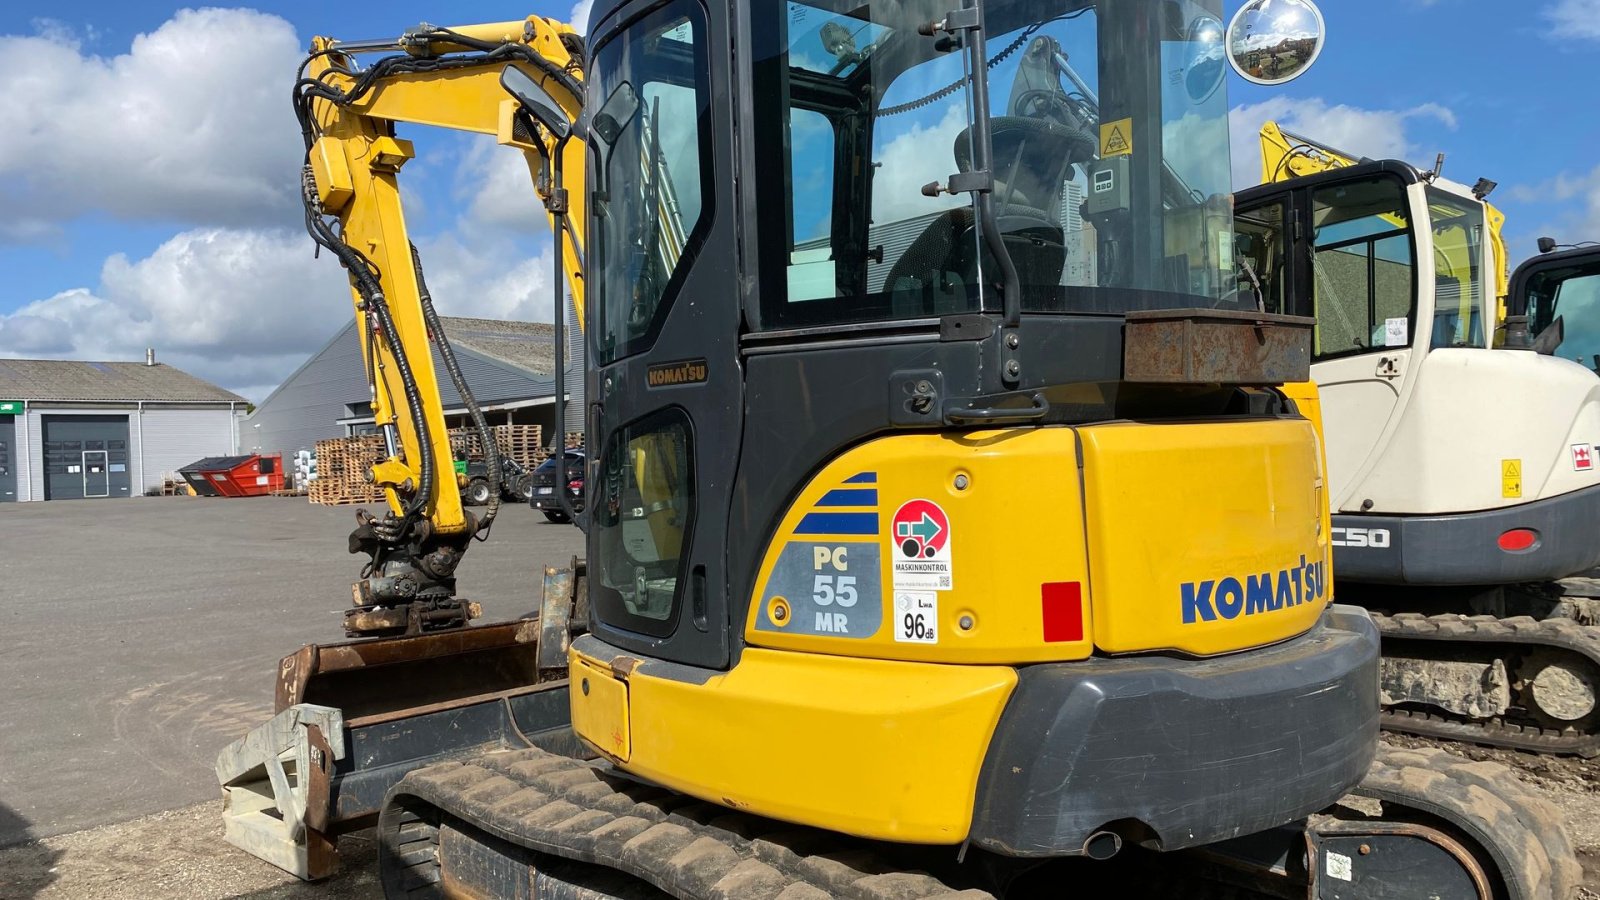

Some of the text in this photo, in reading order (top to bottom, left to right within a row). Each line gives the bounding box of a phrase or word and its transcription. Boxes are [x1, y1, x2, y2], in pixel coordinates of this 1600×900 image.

[649, 363, 705, 385] KOMATSU
[813, 546, 848, 571] PC
[895, 563, 948, 572] MASKINKONTROL
[812, 575, 858, 608] 55
[1180, 554, 1323, 624] KOMATSU
[815, 612, 848, 633] MR
[904, 613, 925, 639] 96
